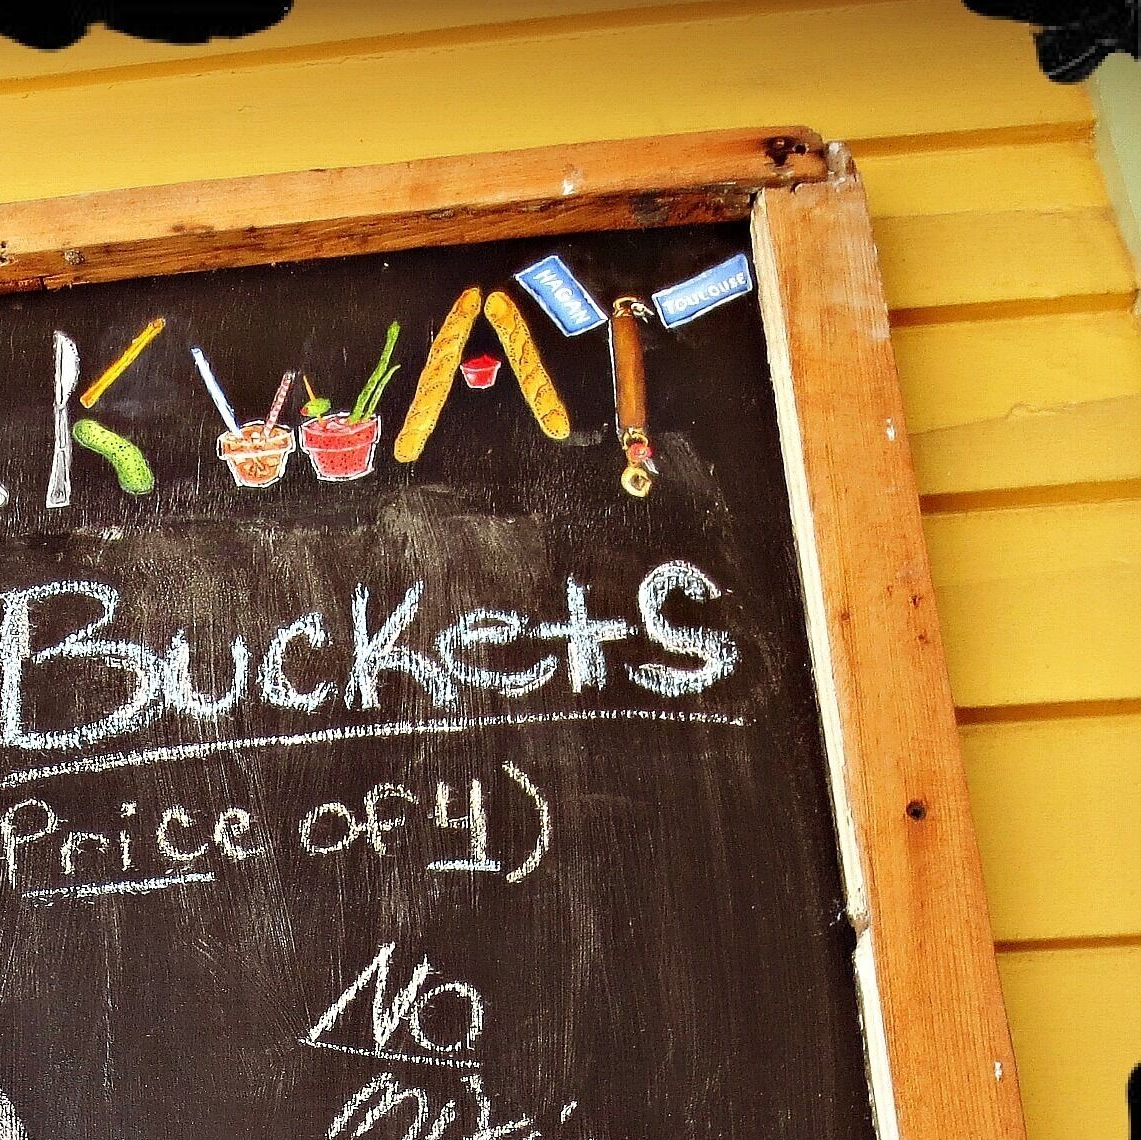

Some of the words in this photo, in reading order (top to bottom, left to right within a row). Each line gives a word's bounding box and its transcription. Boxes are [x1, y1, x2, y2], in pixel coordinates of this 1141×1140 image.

[533, 269, 591, 326] HAGAN
[663, 272, 747, 315] TOULOUSE
[0, 799, 264, 889] Price
[299, 783, 419, 857] of
